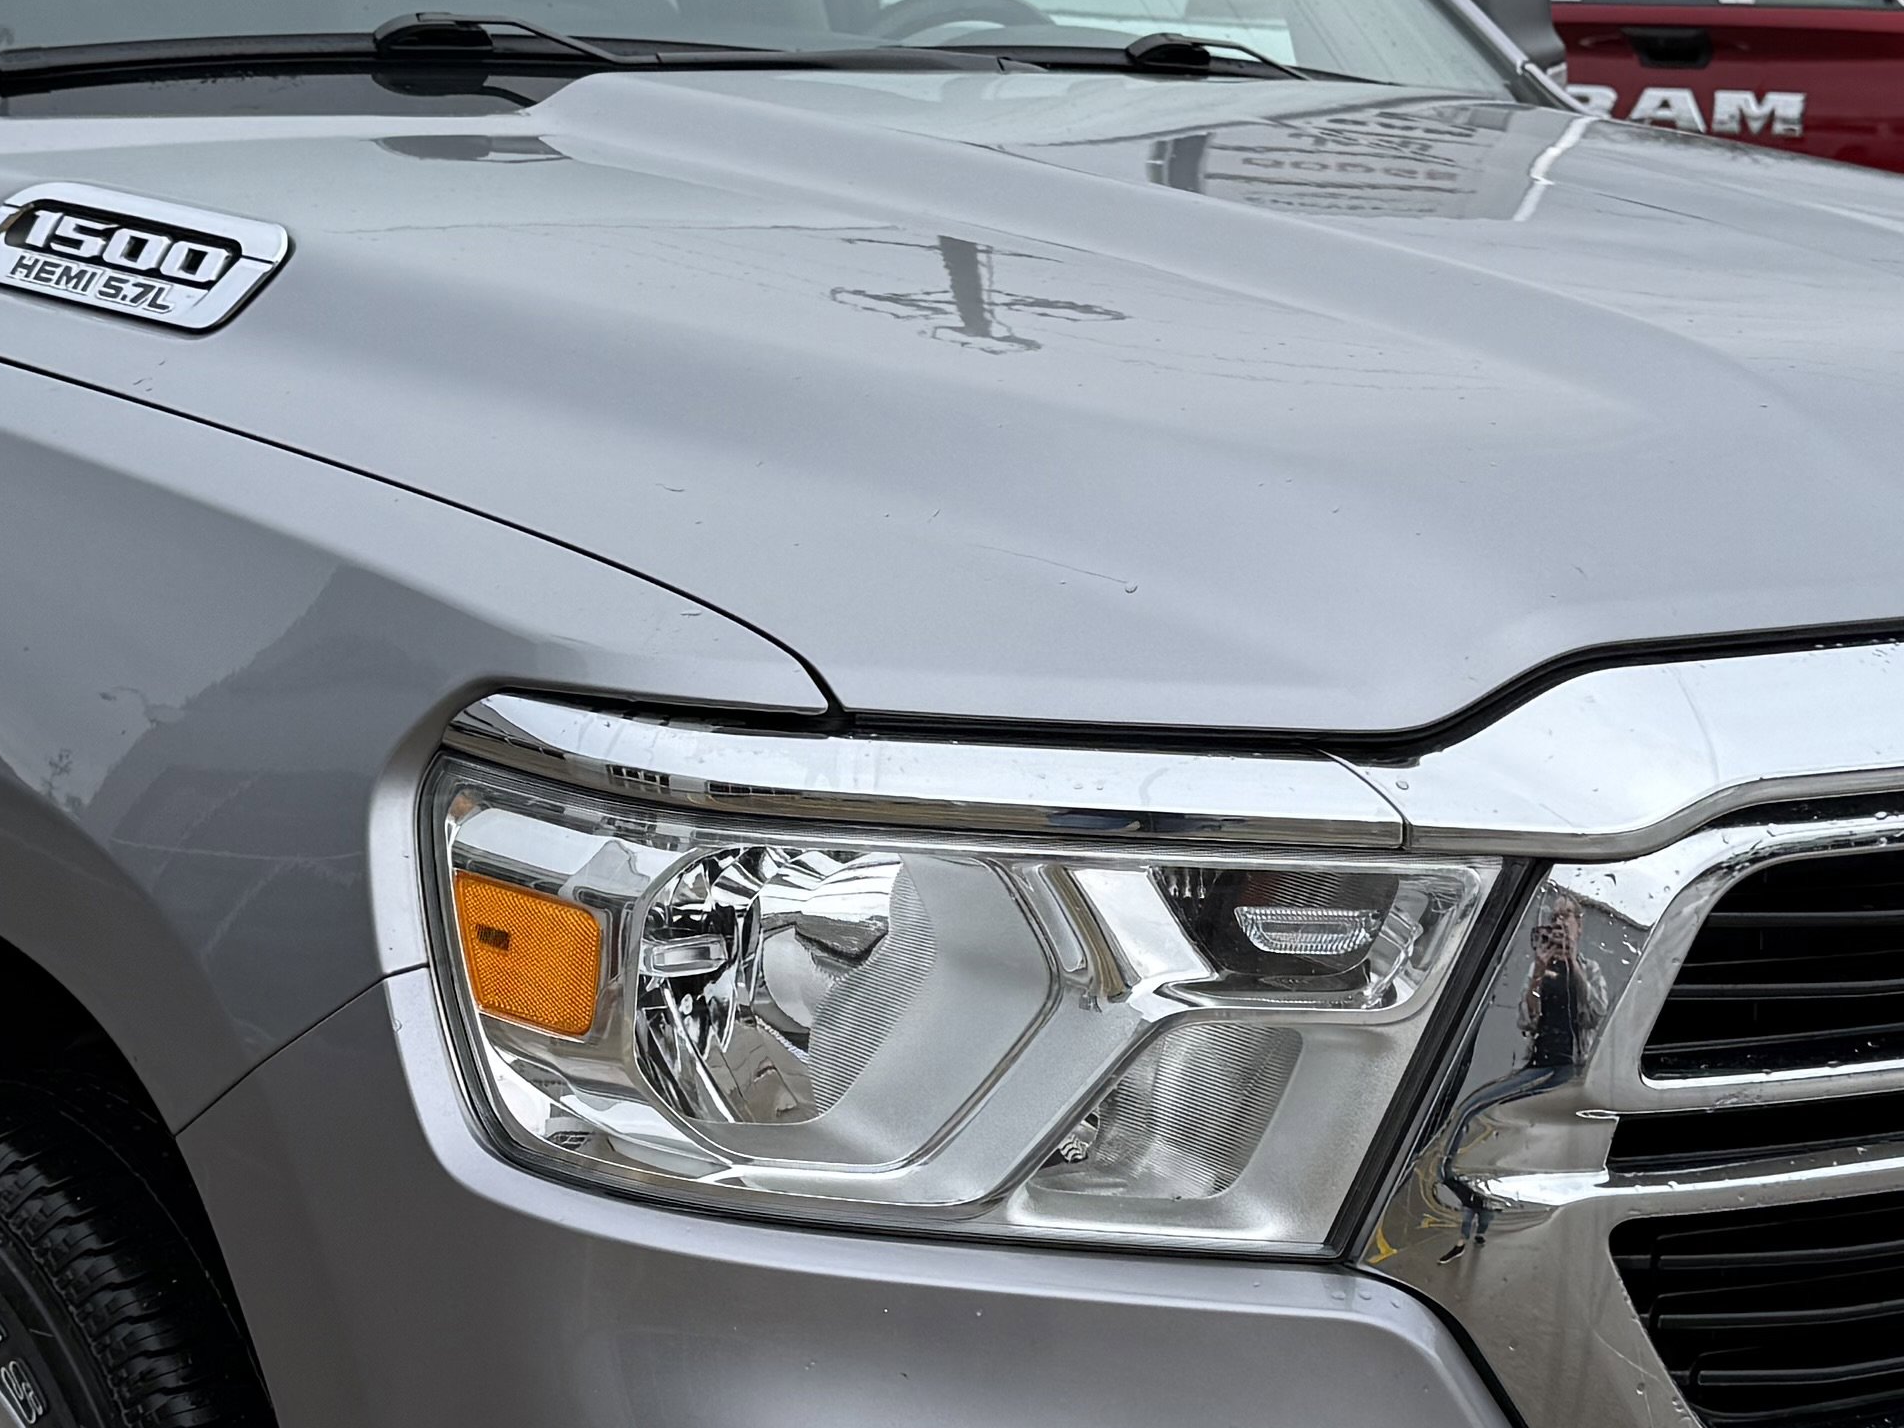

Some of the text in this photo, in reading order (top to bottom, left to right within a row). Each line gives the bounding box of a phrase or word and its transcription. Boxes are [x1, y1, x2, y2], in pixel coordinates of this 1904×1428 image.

[25, 209, 233, 284] 1500
[7, 254, 174, 314] HEMI 5.7L
